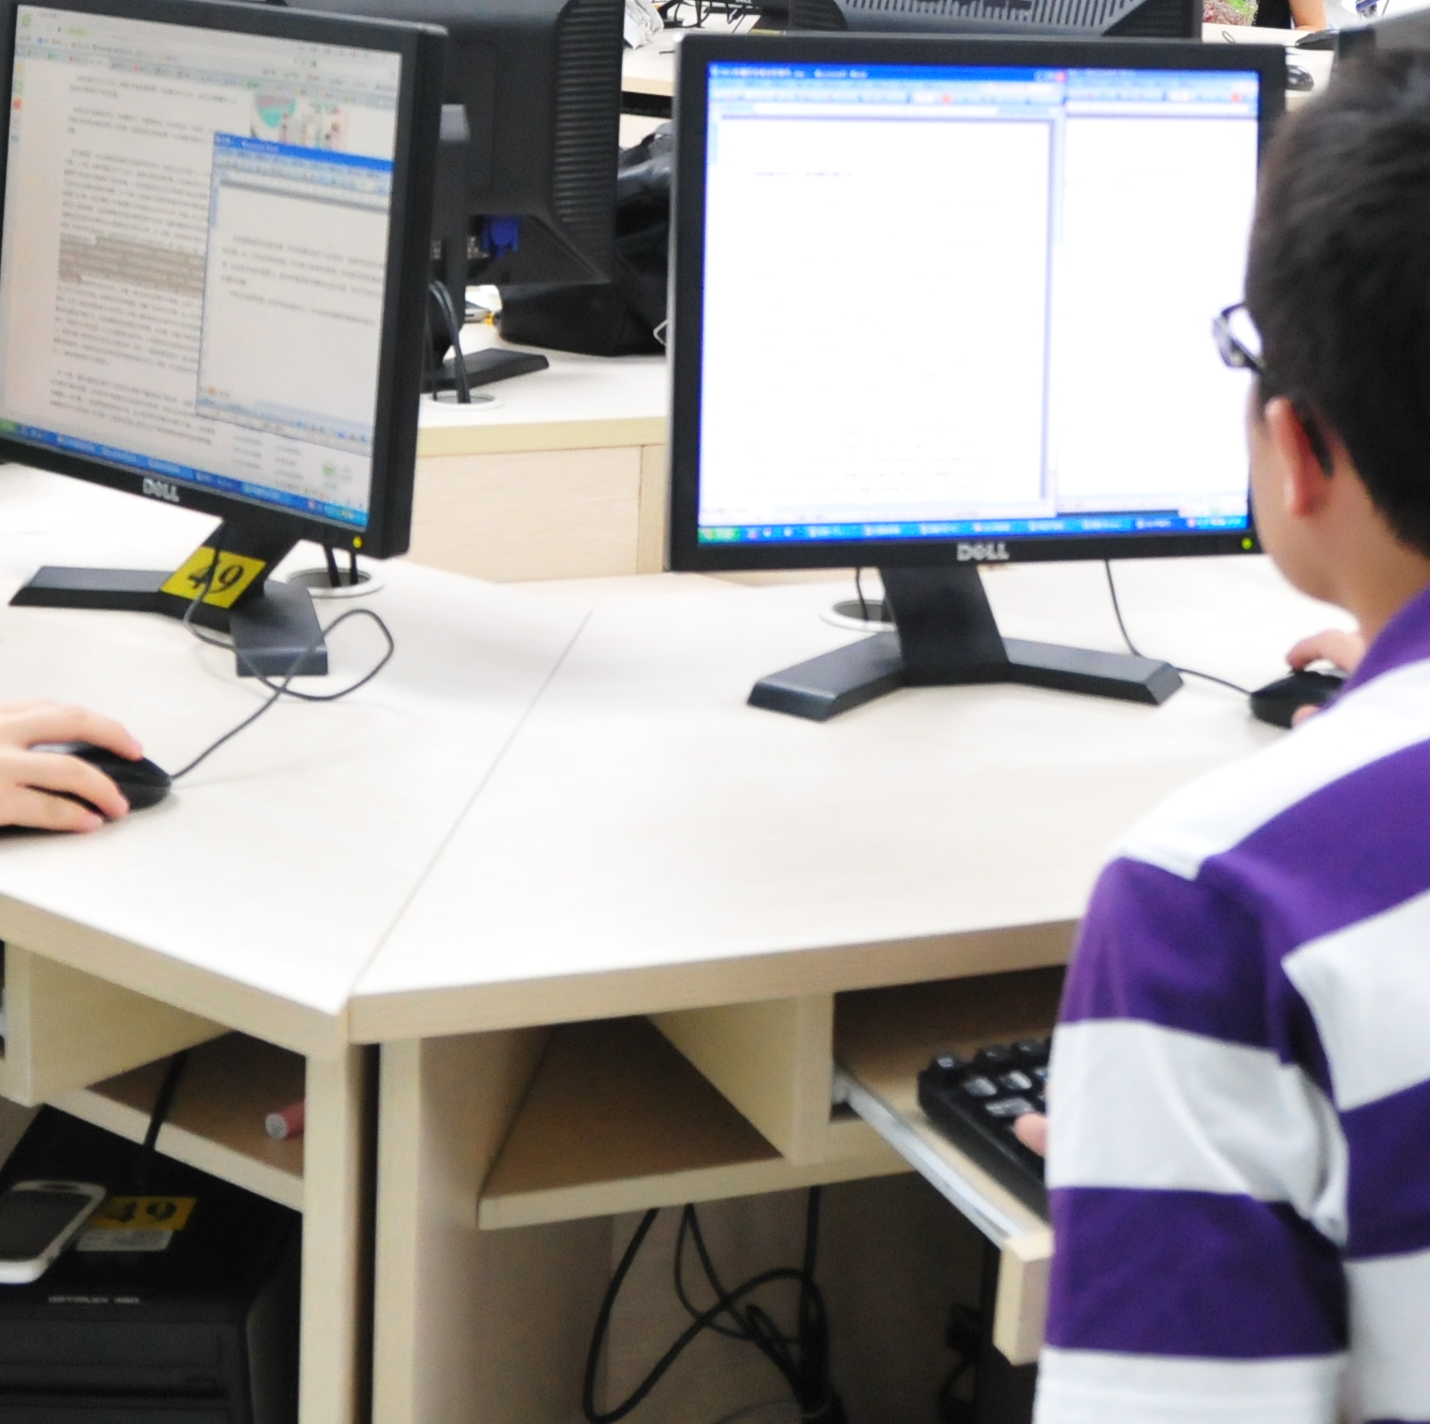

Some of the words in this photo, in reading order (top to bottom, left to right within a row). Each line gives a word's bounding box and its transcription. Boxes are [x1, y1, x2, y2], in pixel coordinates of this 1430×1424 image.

[142, 478, 180, 503] DELL
[956, 542, 1010, 562] DELL
[187, 562, 245, 595] 49
